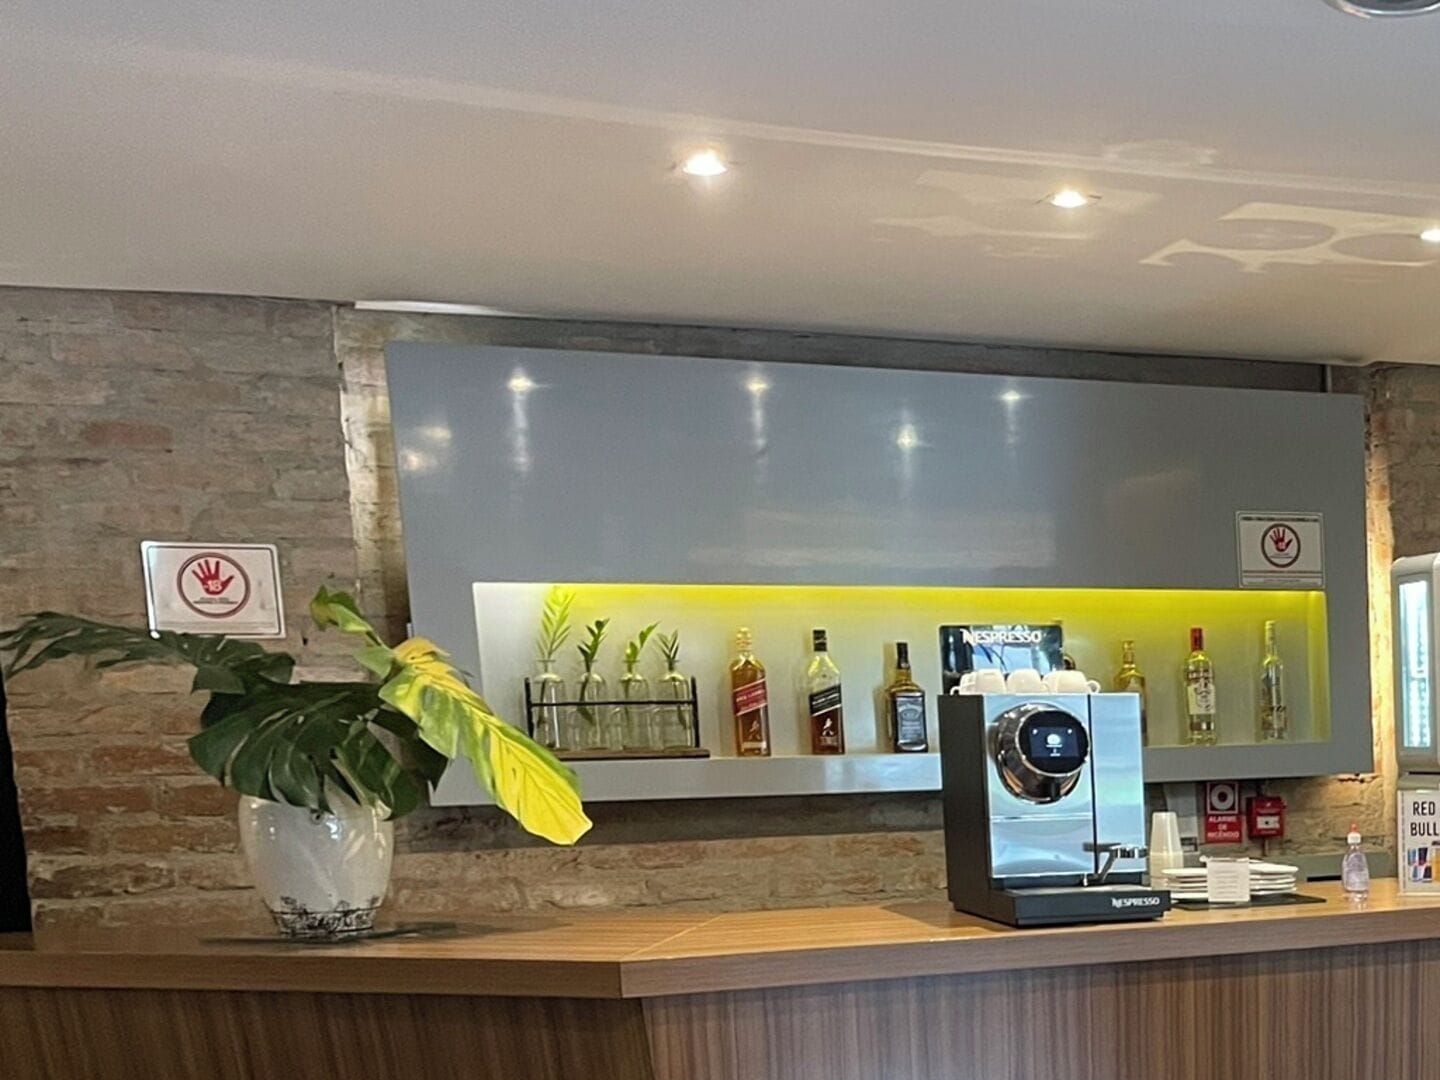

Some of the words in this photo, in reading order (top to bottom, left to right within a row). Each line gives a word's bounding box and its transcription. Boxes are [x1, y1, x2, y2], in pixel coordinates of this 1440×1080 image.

[960, 628, 1042, 645] NESPRESSO
[1412, 801, 1436, 816] RED
[1410, 822, 1439, 836] BULL
[1112, 897, 1160, 908] NESPRESSO
